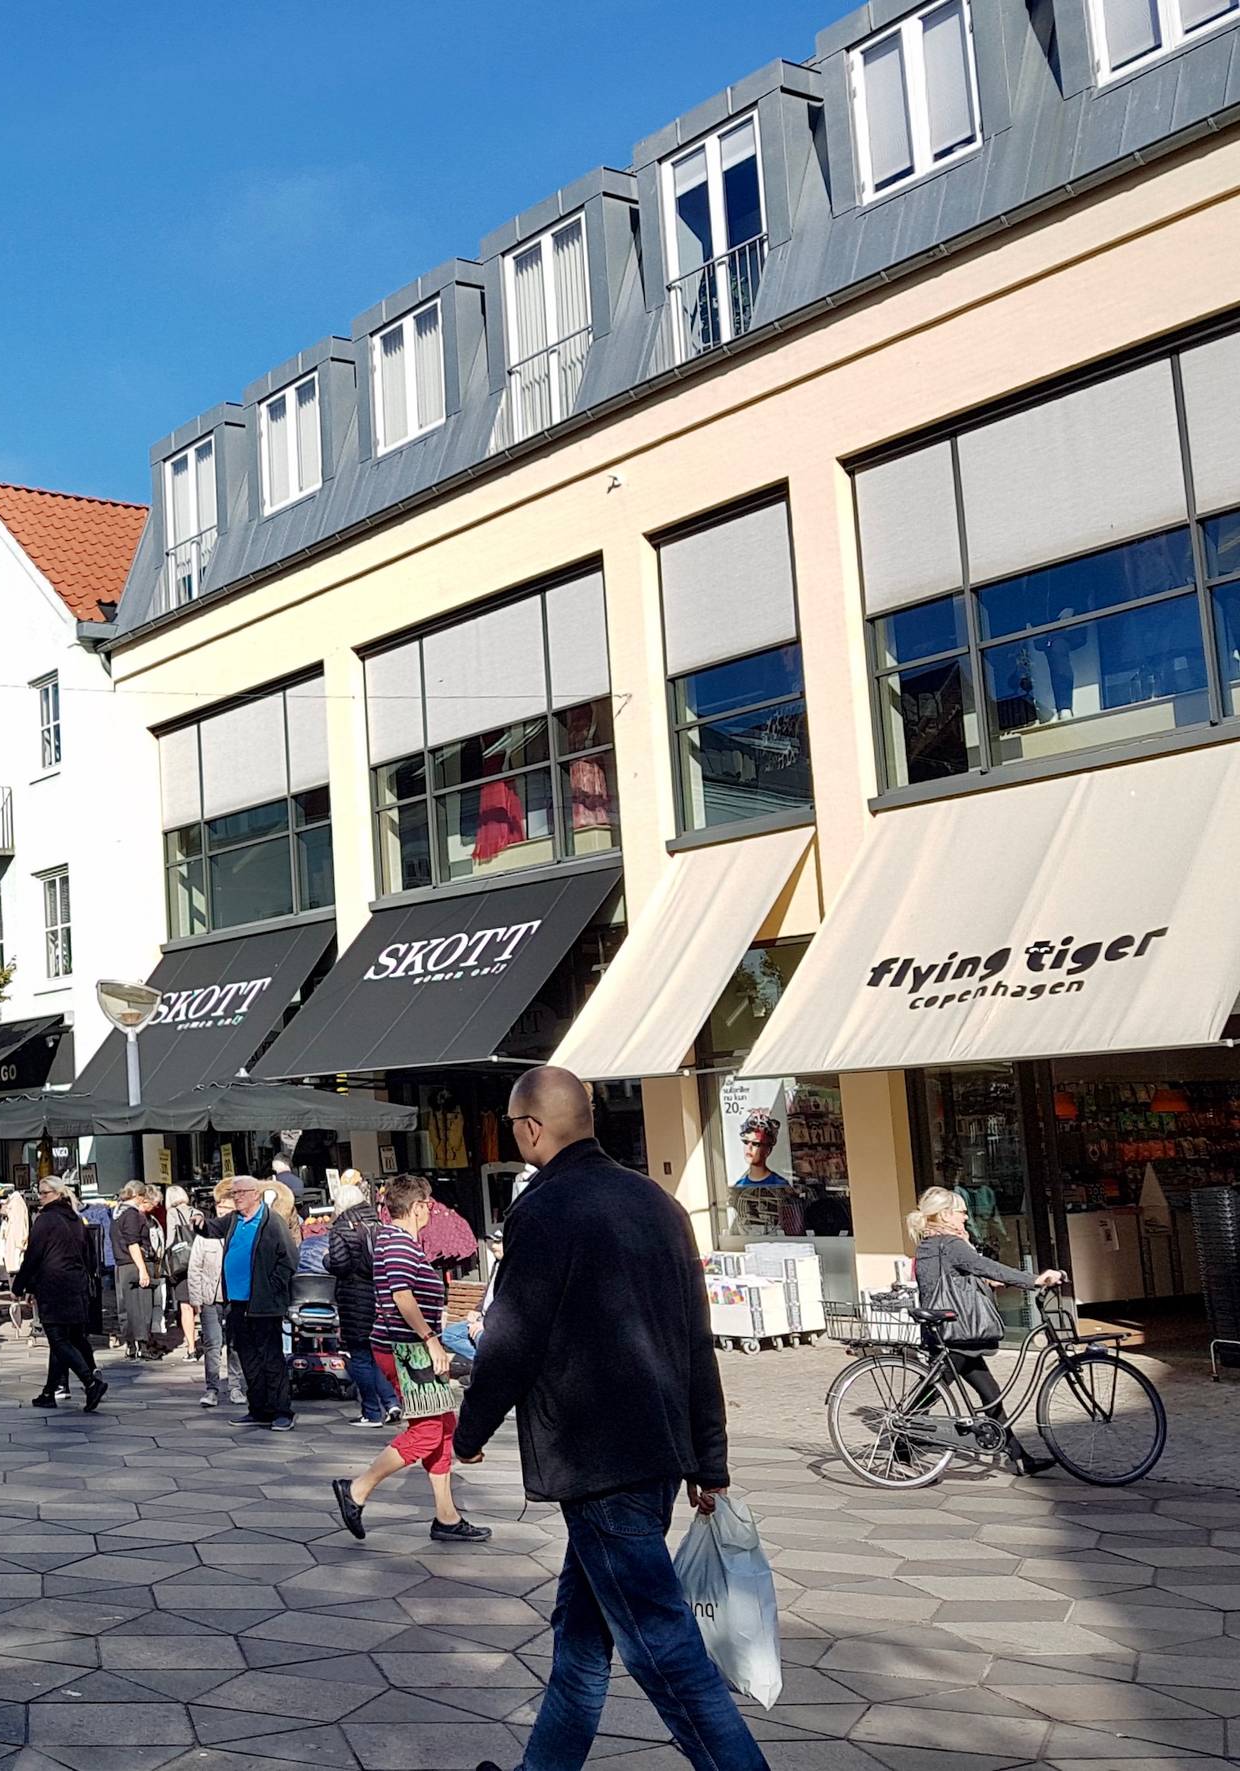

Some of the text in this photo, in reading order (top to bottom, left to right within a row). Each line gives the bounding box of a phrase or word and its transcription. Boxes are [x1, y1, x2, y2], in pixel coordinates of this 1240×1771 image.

[363, 919, 542, 980] SKOTT
[413, 962, 508, 985] women only
[866, 926, 1169, 994] flying tiger
[148, 976, 272, 1025] SKOTT
[909, 980, 1085, 1010] copenhagen
